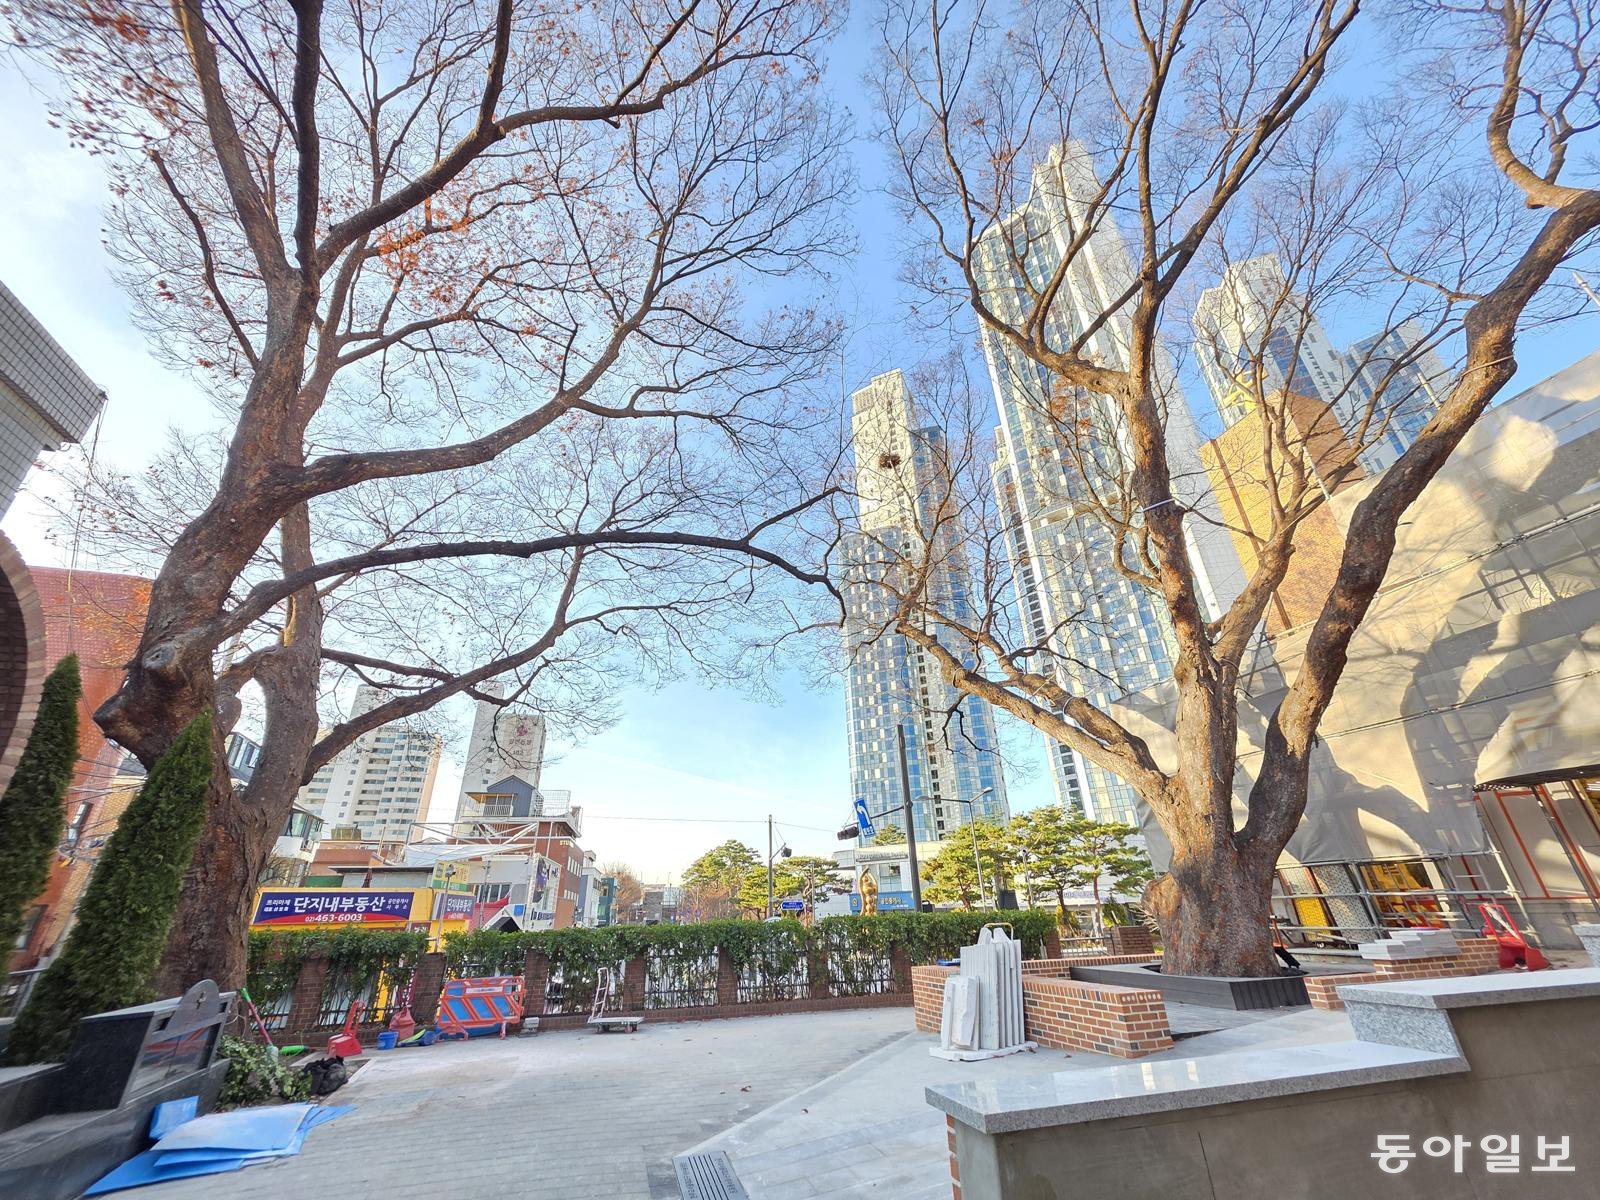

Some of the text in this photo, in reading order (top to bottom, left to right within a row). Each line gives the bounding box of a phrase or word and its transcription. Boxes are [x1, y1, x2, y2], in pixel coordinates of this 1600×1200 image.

[293, 896, 387, 913] 단지내부동산
[447, 898, 473, 912] 단지내부동산
[305, 913, 363, 923] 02)463-6003
